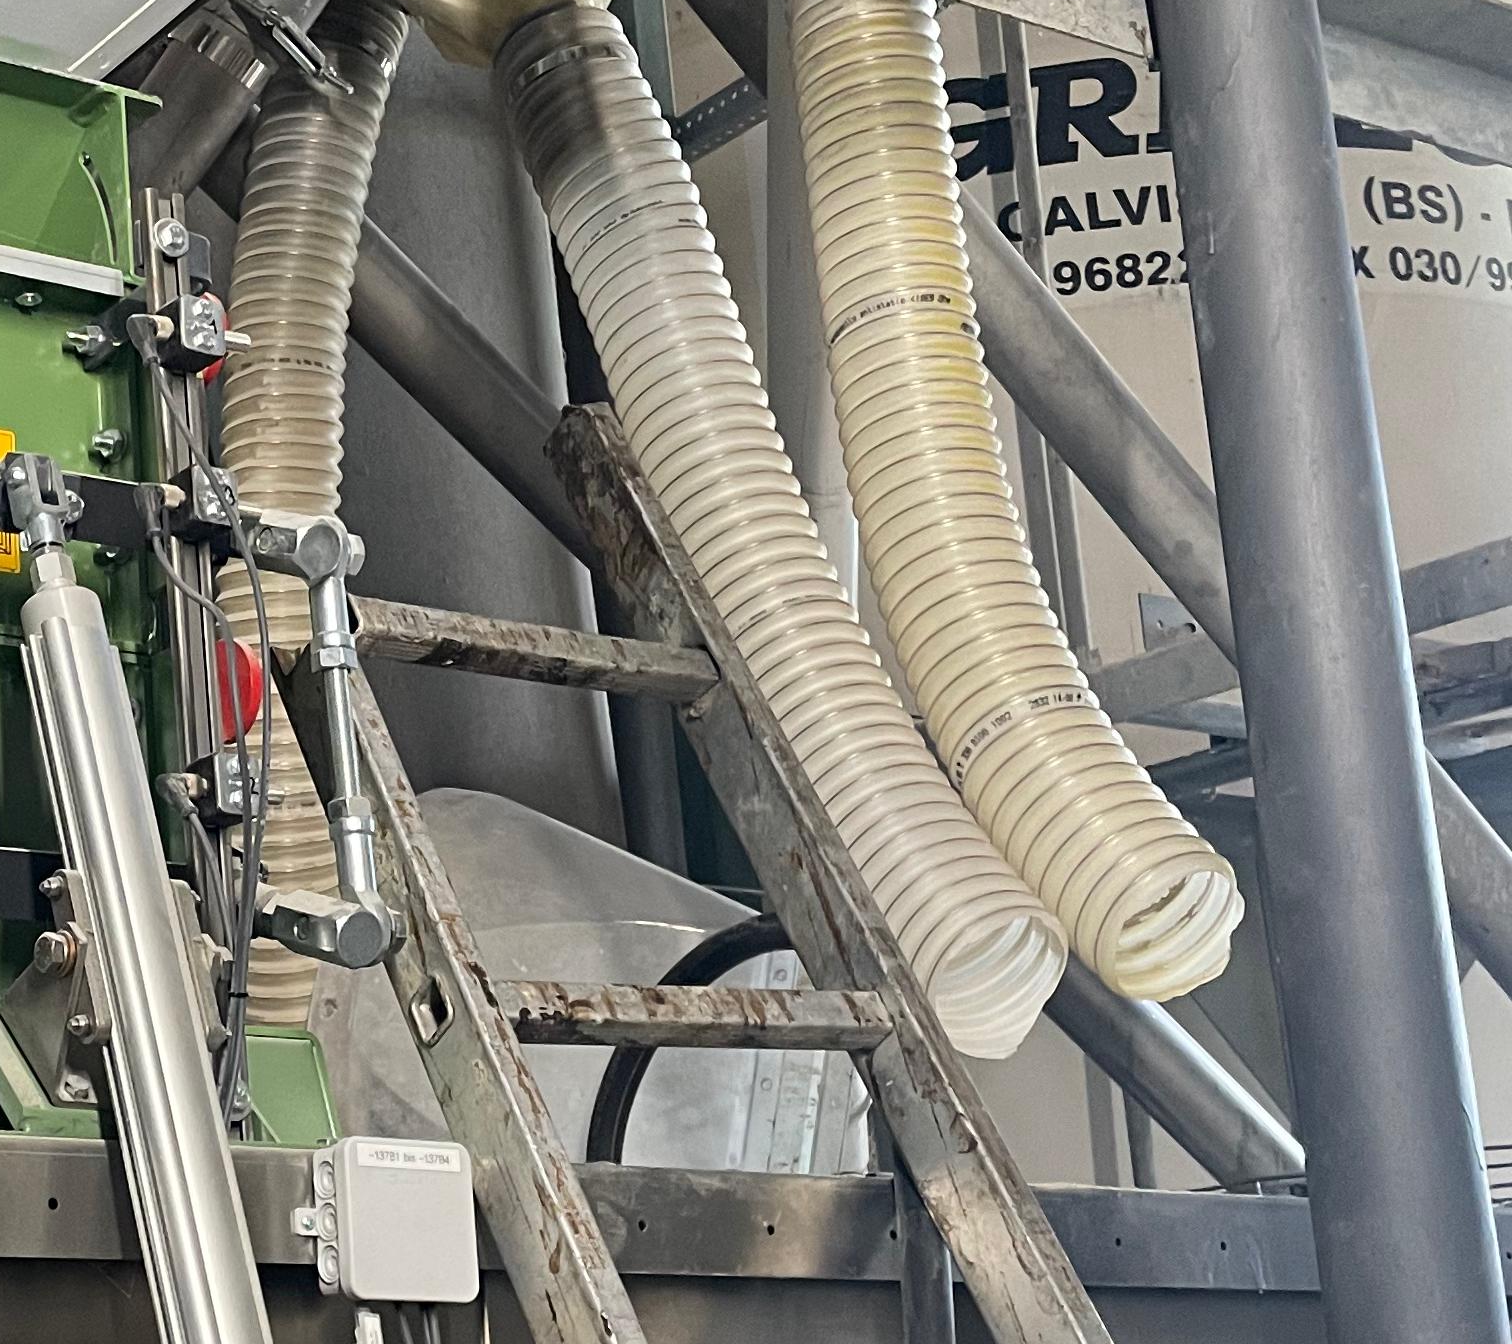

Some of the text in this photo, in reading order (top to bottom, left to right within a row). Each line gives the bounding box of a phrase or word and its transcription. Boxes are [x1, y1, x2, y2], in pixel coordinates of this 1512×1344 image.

[997, 184, 1178, 242] CALVI
[1363, 175, 1464, 233] (BS)
[1388, 245, 1512, 292] 030/9
